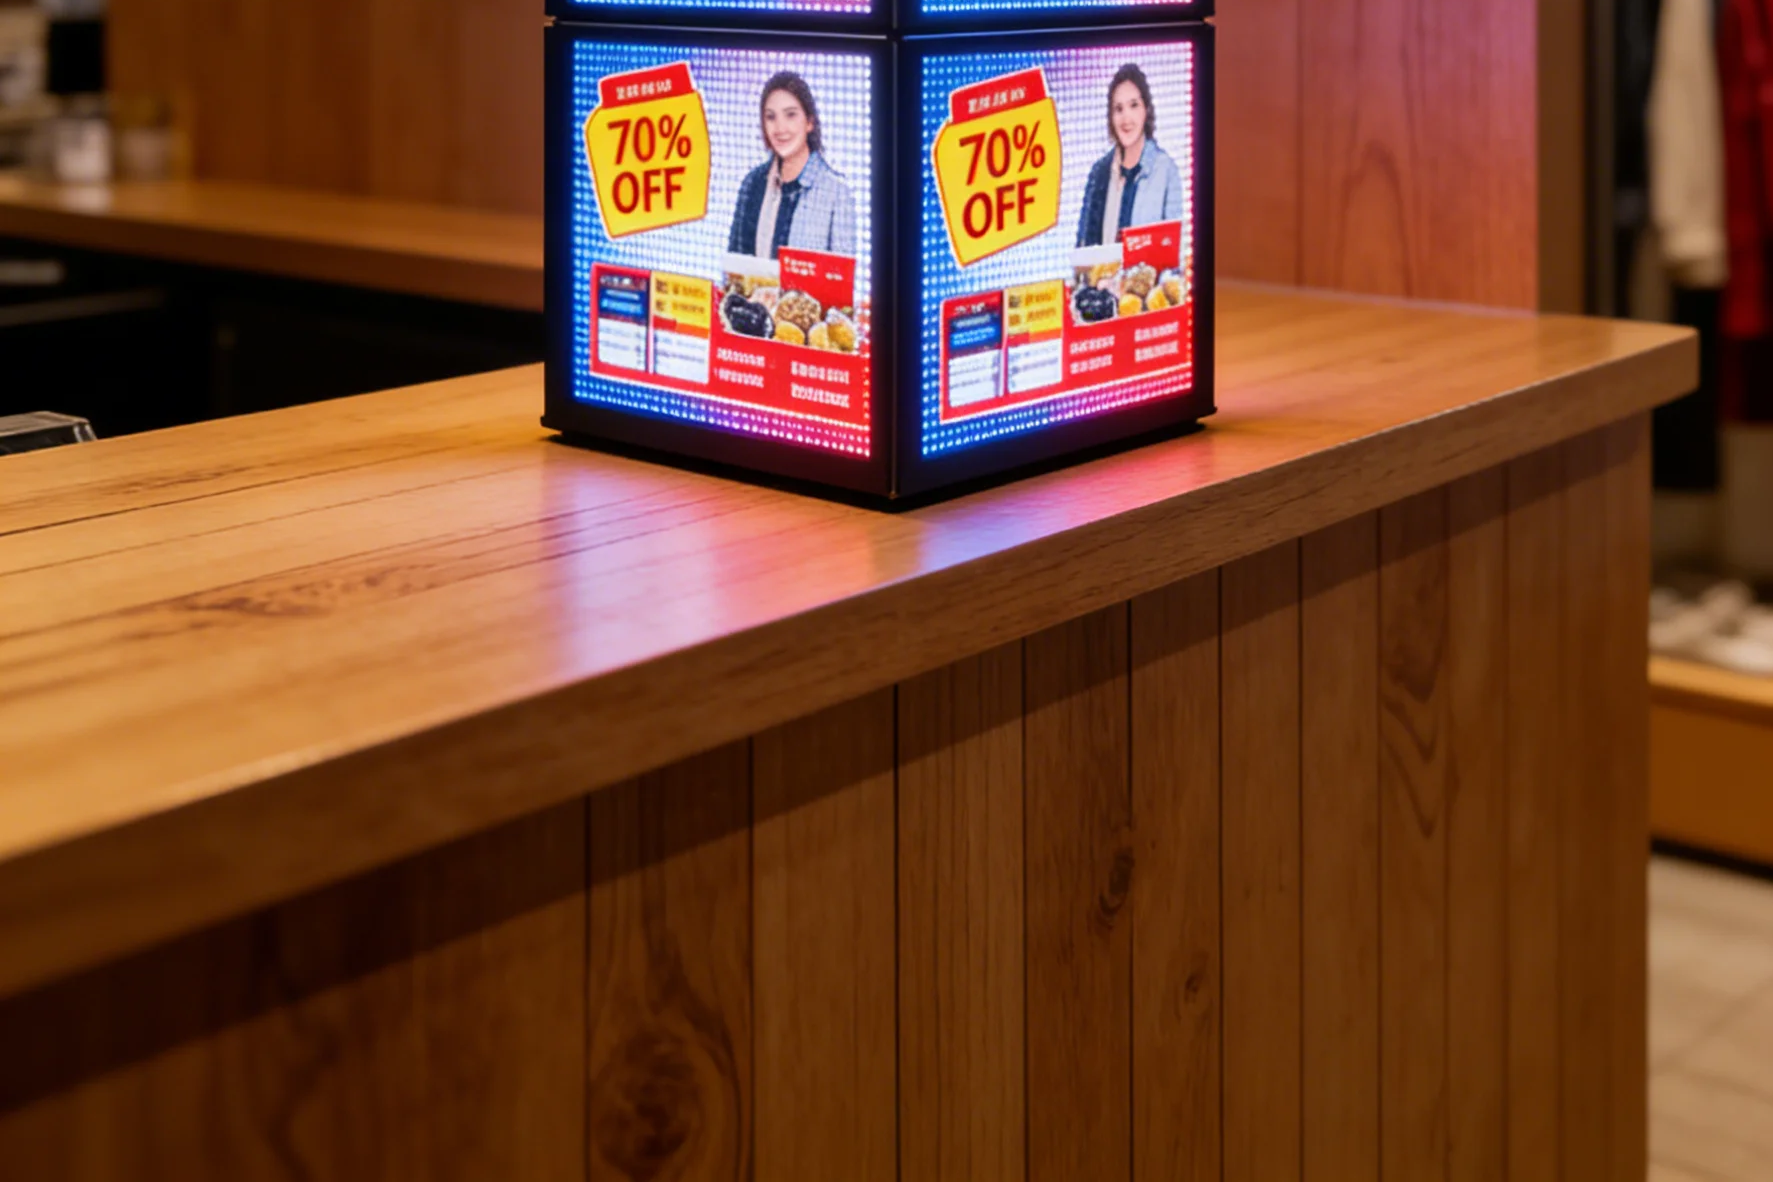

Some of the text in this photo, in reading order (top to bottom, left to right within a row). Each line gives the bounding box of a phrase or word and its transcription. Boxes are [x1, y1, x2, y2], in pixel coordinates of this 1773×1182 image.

[607, 113, 692, 166] 70%
[959, 120, 1046, 186] 70%
[612, 166, 686, 215] OFF
[963, 178, 1038, 240] OFF
